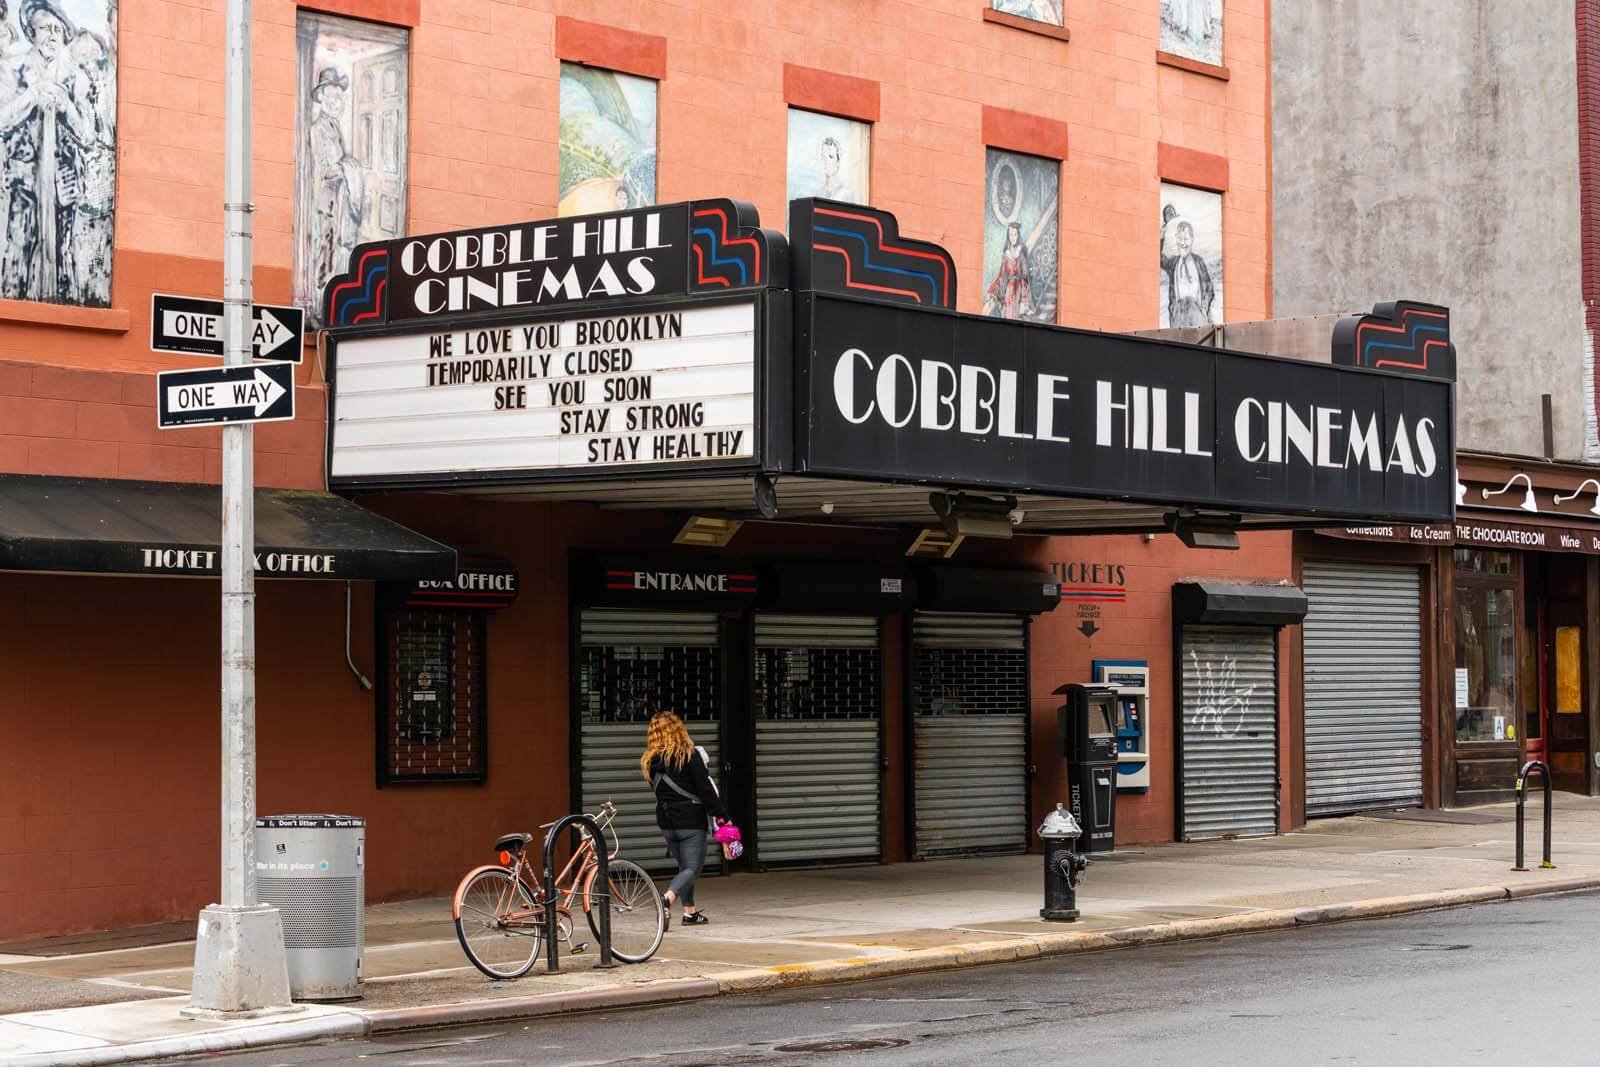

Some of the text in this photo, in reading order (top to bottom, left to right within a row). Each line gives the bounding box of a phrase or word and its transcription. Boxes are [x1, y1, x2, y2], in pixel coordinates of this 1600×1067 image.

[401, 213, 672, 276] COBBLE HILL
[414, 256, 656, 314] CINEMAS
[175, 314, 280, 344] ONE AY
[430, 313, 682, 358] WE LOVE YOU BROOKLYN
[427, 348, 632, 386] TEMPORARILY CLOSED
[178, 382, 271, 409] ONE WAY
[495, 375, 652, 410] SEE YOU SOON
[561, 402, 704, 434] STAY STRONG
[833, 348, 1437, 478] COBBLE HILL CINEMAS
[588, 430, 743, 463] STAY HEALTHY
[1410, 526, 1451, 540] Ice Cream
[1456, 525, 1545, 545] THE CHOCOLATE ROOM
[1560, 535, 1580, 548] Wine
[140, 549, 216, 569] TICKET
[265, 553, 336, 573] OFFICE
[1049, 561, 1126, 586] TICKETS
[458, 573, 515, 590] OFFICE
[634, 571, 728, 592] ENTRANCE
[1072, 784, 1081, 823] TICKETS
[279, 819, 318, 827] Don't litter
[335, 819, 352, 827] Don't
